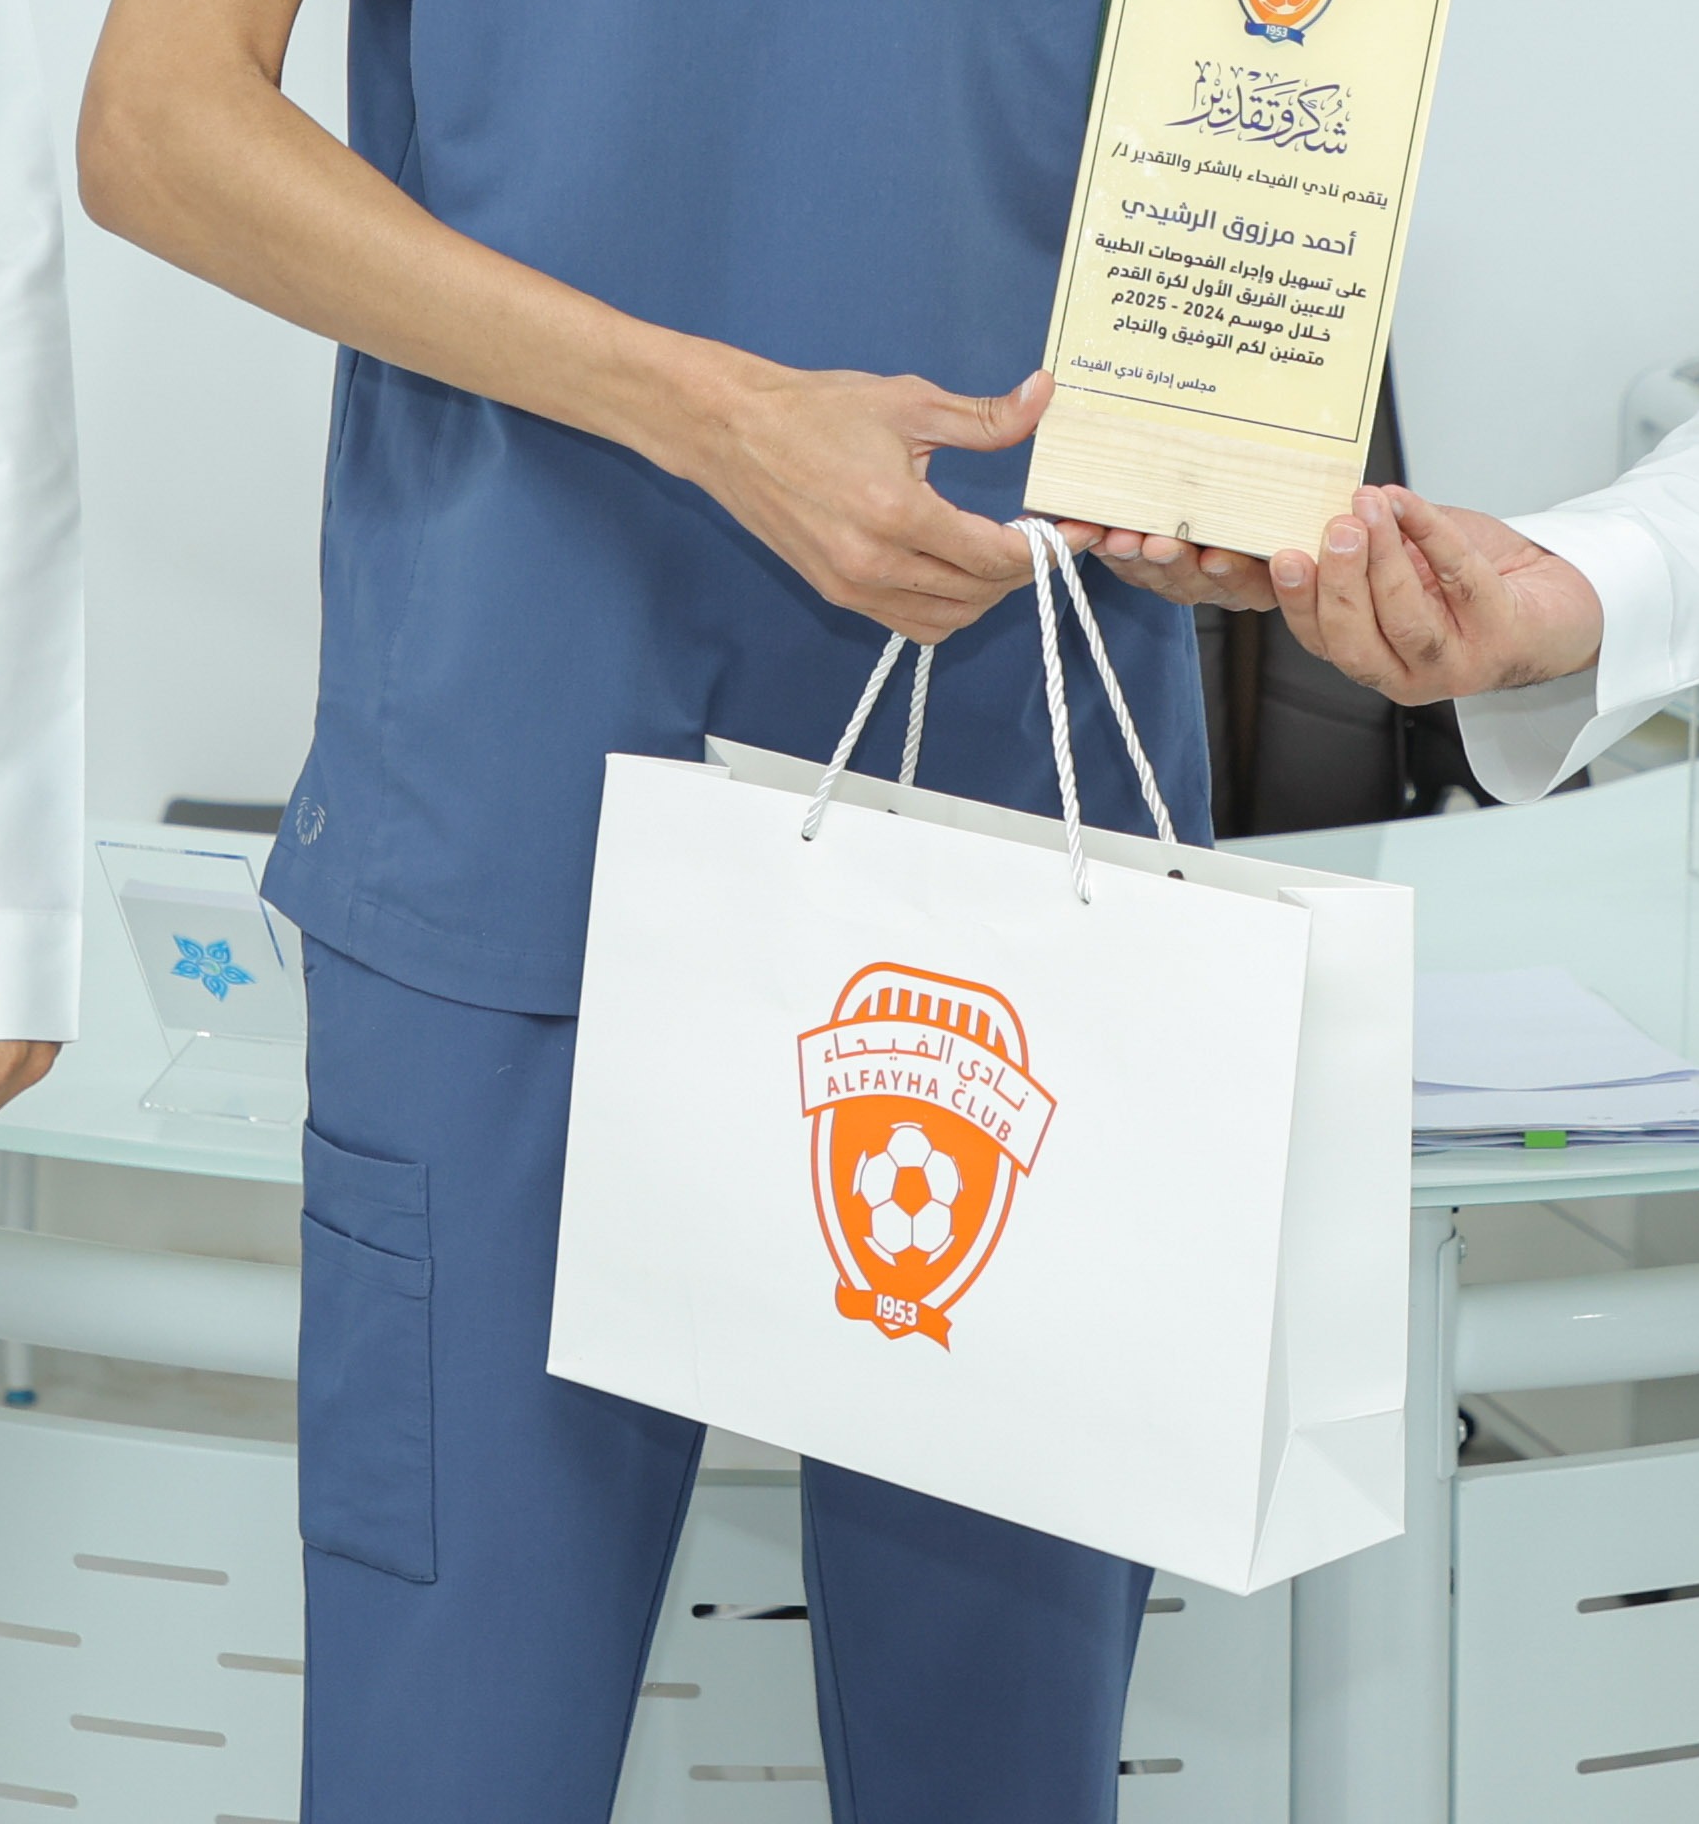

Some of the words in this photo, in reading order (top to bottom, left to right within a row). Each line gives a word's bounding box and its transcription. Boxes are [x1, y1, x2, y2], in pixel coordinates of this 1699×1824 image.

[1265, 24, 1288, 37] 1953
[1130, 147, 1191, 173] والتقدير
[1194, 159, 1243, 182] بالشكر
[1247, 168, 1298, 192] الفيحاء
[1302, 181, 1339, 198] نادي
[1342, 187, 1388, 210] يتقدم
[1121, 197, 1216, 232] الرشيدي
[1222, 216, 1294, 248] مرزوق
[1302, 230, 1357, 256] أحمد
[1095, 232, 1144, 256] الطبية
[1148, 246, 1226, 271] الفحوصات
[1107, 263, 1152, 282] القدم
[1156, 268, 1188, 290] لكرة
[1230, 262, 1274, 284] وإجراء
[1278, 269, 1332, 292] تسهيل
[1192, 278, 1232, 298] الأول
[1236, 288, 1286, 309] الفريق
[1335, 281, 1367, 299] على
[1183, 301, 1225, 322] 2024
[1290, 299, 1345, 320] للاعبين
[1113, 315, 1167, 339] والنجاح
[1172, 326, 1233, 350] التوفيق
[1236, 338, 1266, 356] لكم
[1270, 346, 1325, 367] متمنين
[1070, 355, 1112, 373] الفيحاء
[1114, 365, 1143, 381] نادي
[1146, 369, 1174, 388] إدارة
[1176, 378, 1217, 393] مجلس
[824, 1032, 954, 1064] الفيحاء
[957, 1059, 1029, 1112] نادي
[827, 1069, 939, 1100] ALFAYHA
[951, 1087, 1012, 1143] CLUB
[876, 1293, 918, 1327] 1953
